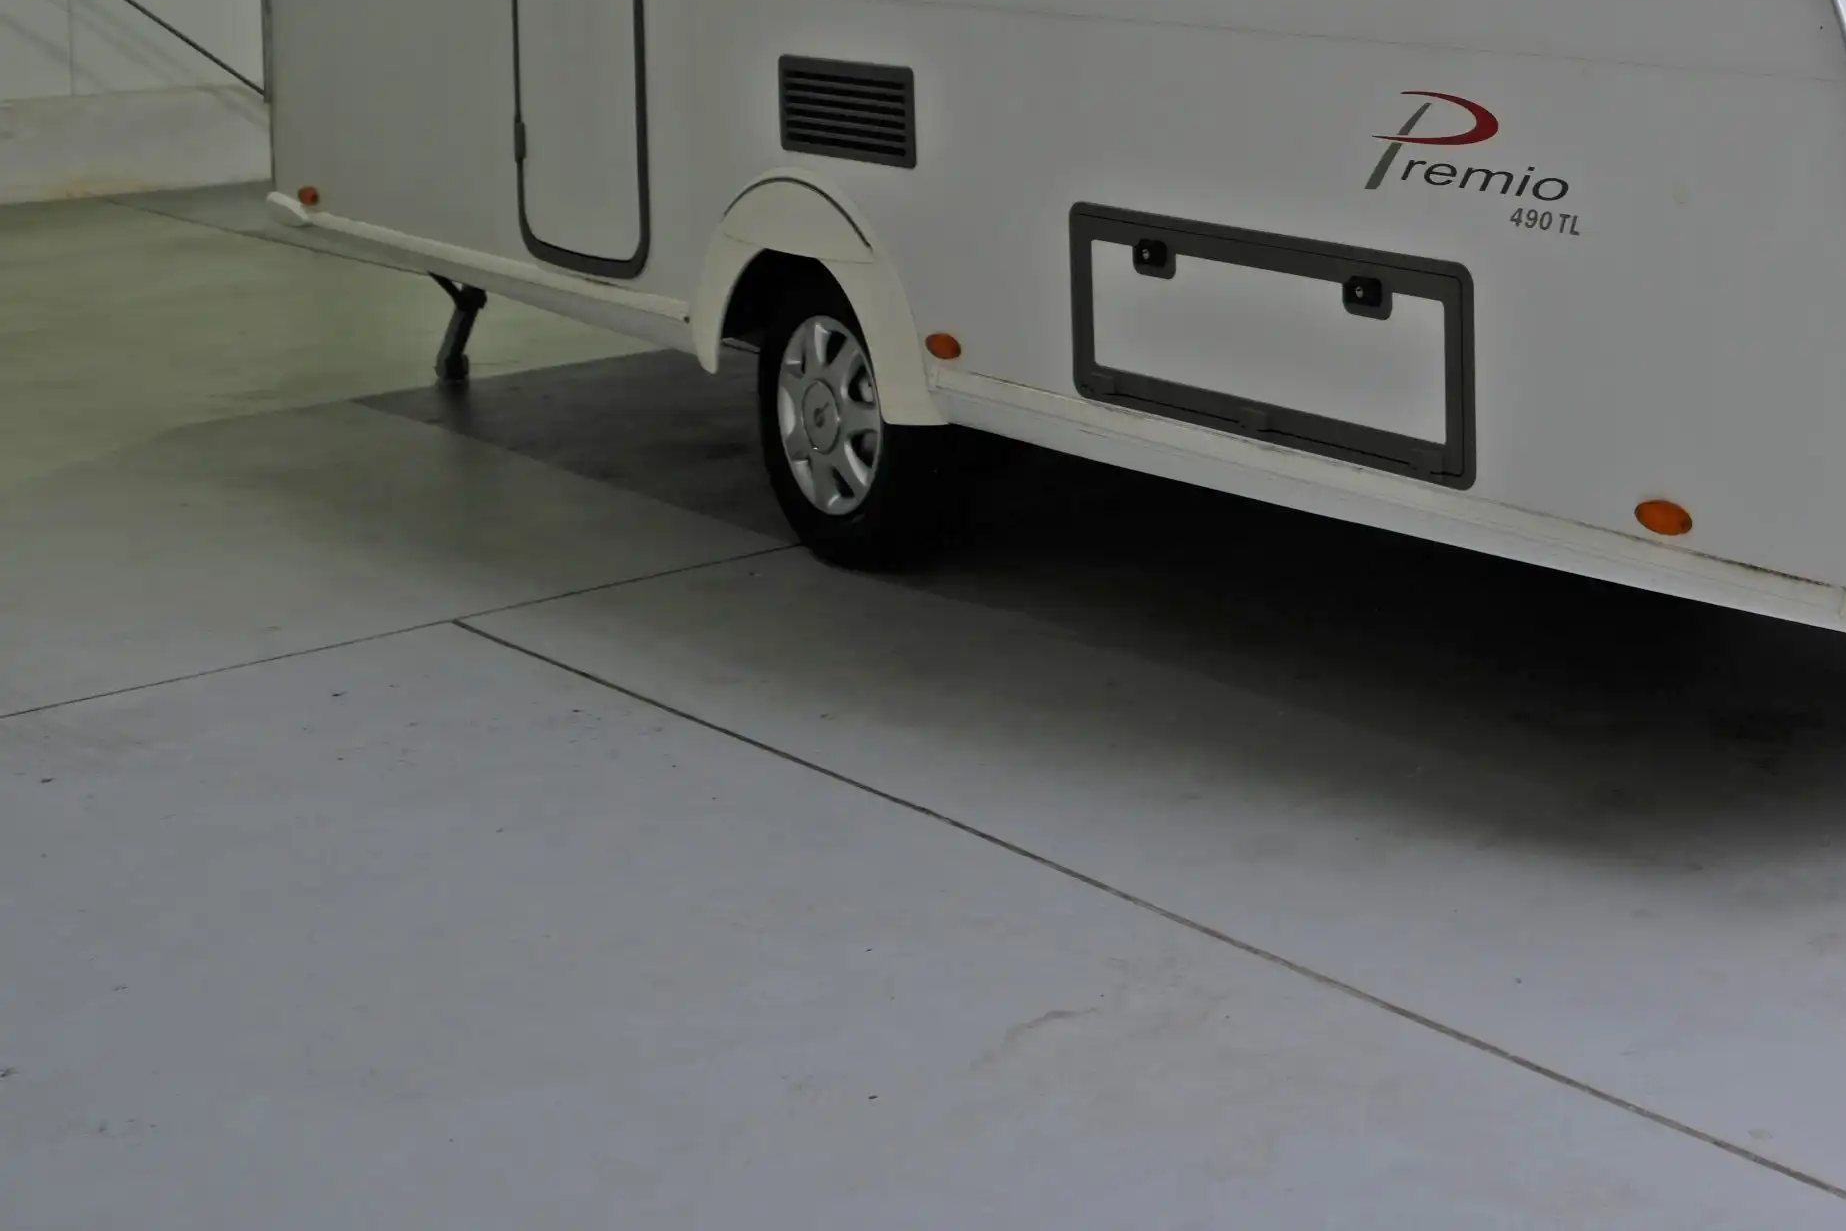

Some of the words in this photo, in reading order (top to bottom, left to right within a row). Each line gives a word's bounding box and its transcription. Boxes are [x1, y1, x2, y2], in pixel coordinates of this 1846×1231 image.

[1364, 90, 1569, 201] Premio
[1509, 207, 1553, 231] 490
[1557, 212, 1581, 236] TL
